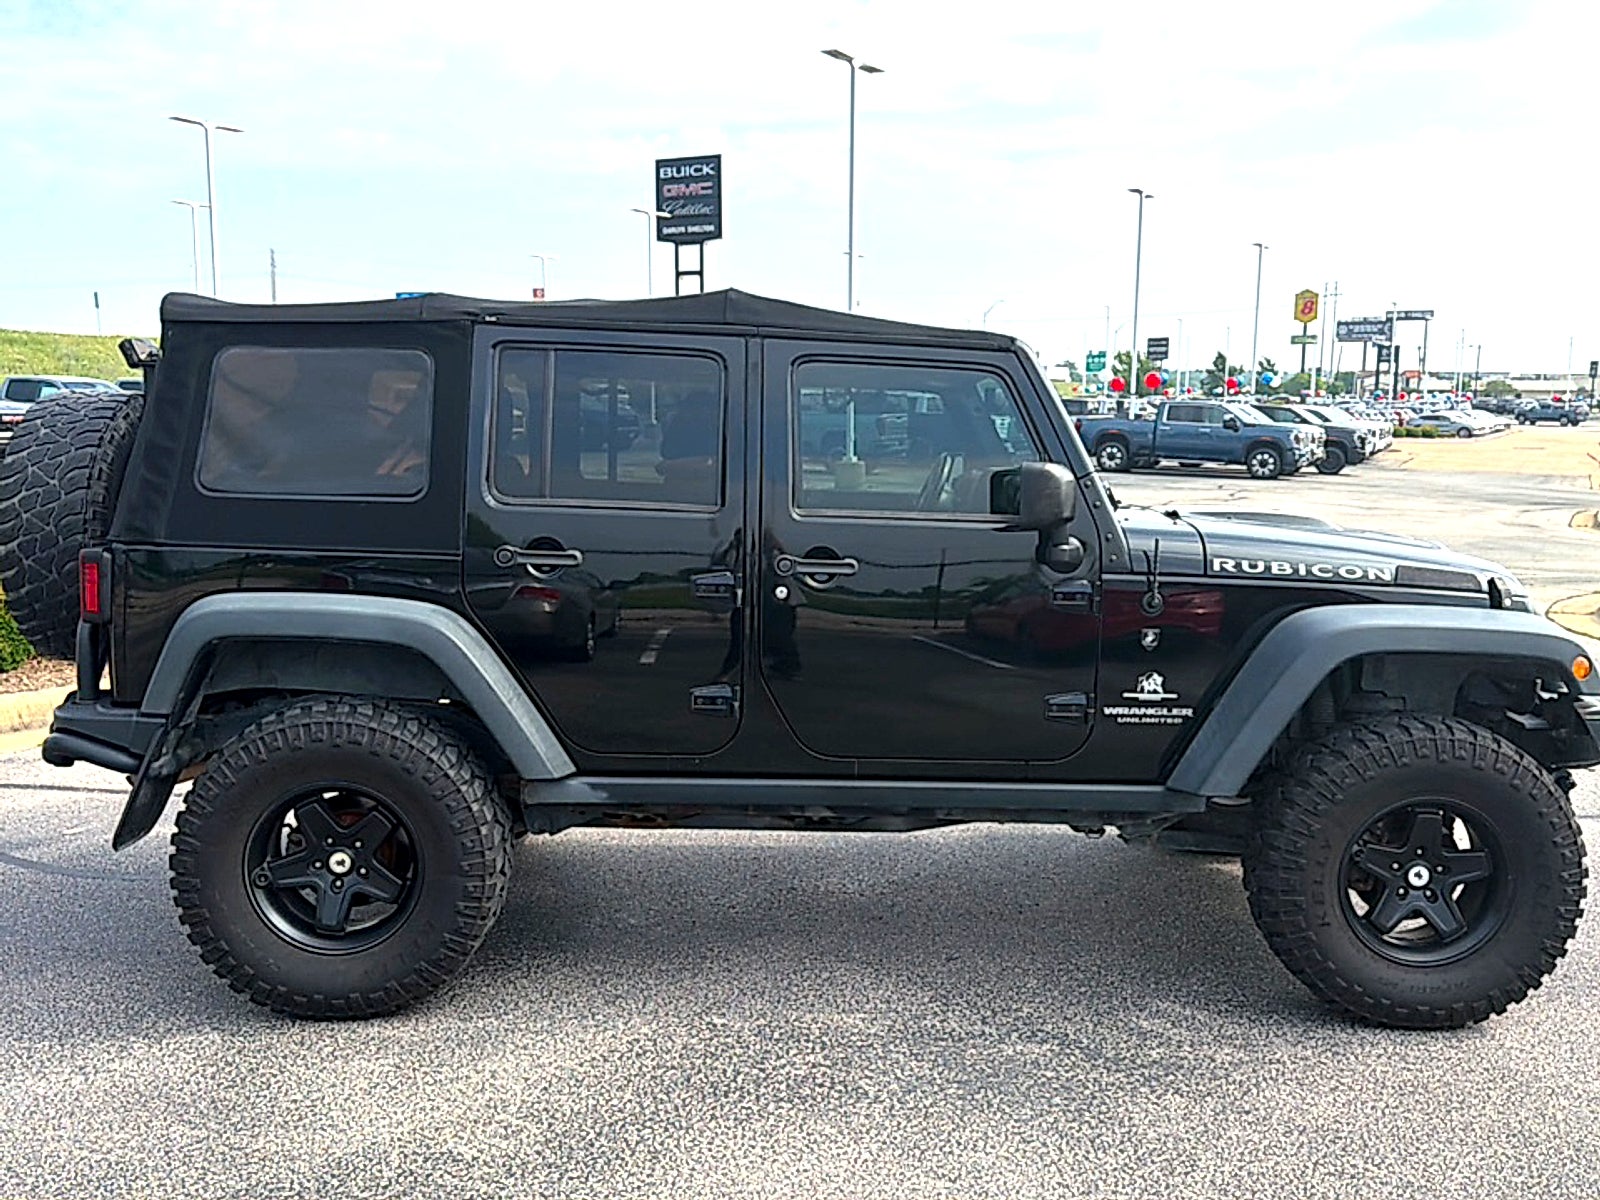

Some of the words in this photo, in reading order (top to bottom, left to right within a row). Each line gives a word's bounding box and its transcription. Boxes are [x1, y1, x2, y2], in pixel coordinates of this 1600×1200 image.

[660, 163, 716, 179] BUICK
[663, 182, 713, 198] GMC
[1301, 300, 1315, 316] 8
[1212, 557, 1393, 582] RUBICON
[1103, 706, 1194, 717] WRANGLER
